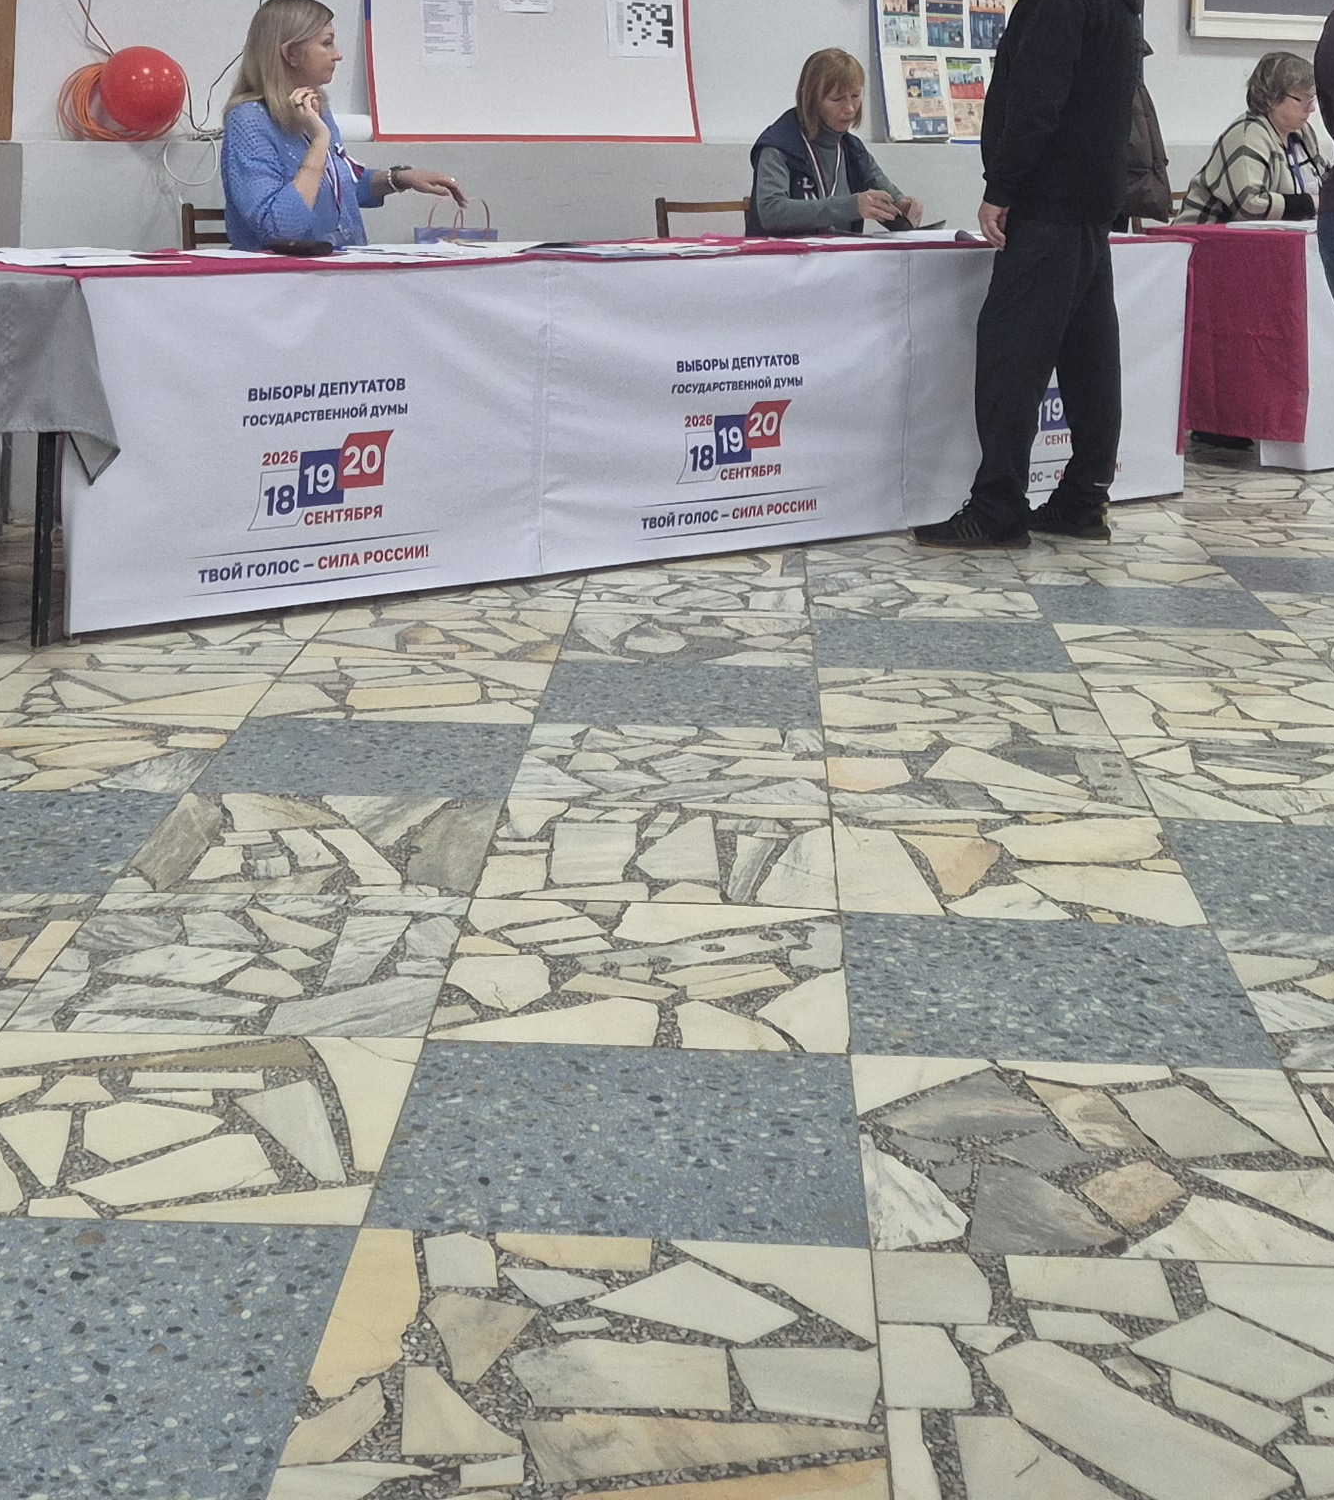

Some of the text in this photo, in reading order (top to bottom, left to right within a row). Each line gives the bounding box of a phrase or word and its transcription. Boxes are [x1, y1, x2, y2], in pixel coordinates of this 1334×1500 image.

[677, 354, 800, 373] ВЫБОРЫ ДЕПУТАТОВ
[248, 378, 406, 401] ВЫБОРЫ ДЕПУТАТОВ
[671, 376, 803, 394] ГОСУДАРСТВЕННОЙ ДУМЫ
[242, 403, 408, 427] ГОСУДАРСТВЕННОЙ ДУМЫ
[684, 414, 713, 428] 2026
[1044, 397, 1064, 422] 19
[689, 411, 779, 472] 18 19 20
[261, 450, 298, 466] 2026
[264, 444, 382, 516] 18 19 20
[720, 463, 781, 481] СЕНТЯБРЯ
[304, 505, 383, 526] СЕНТЯБРЯ
[641, 512, 675, 530] ТВОЙ
[678, 509, 718, 526] ГОЛОС
[732, 505, 764, 520] СИЛА
[766, 499, 817, 516] РОССИИ!
[198, 562, 242, 584] ТВОЙ
[247, 559, 300, 579] ГОЛОС
[317, 553, 360, 570] СИЛА
[363, 544, 429, 564] РОССИИ!
